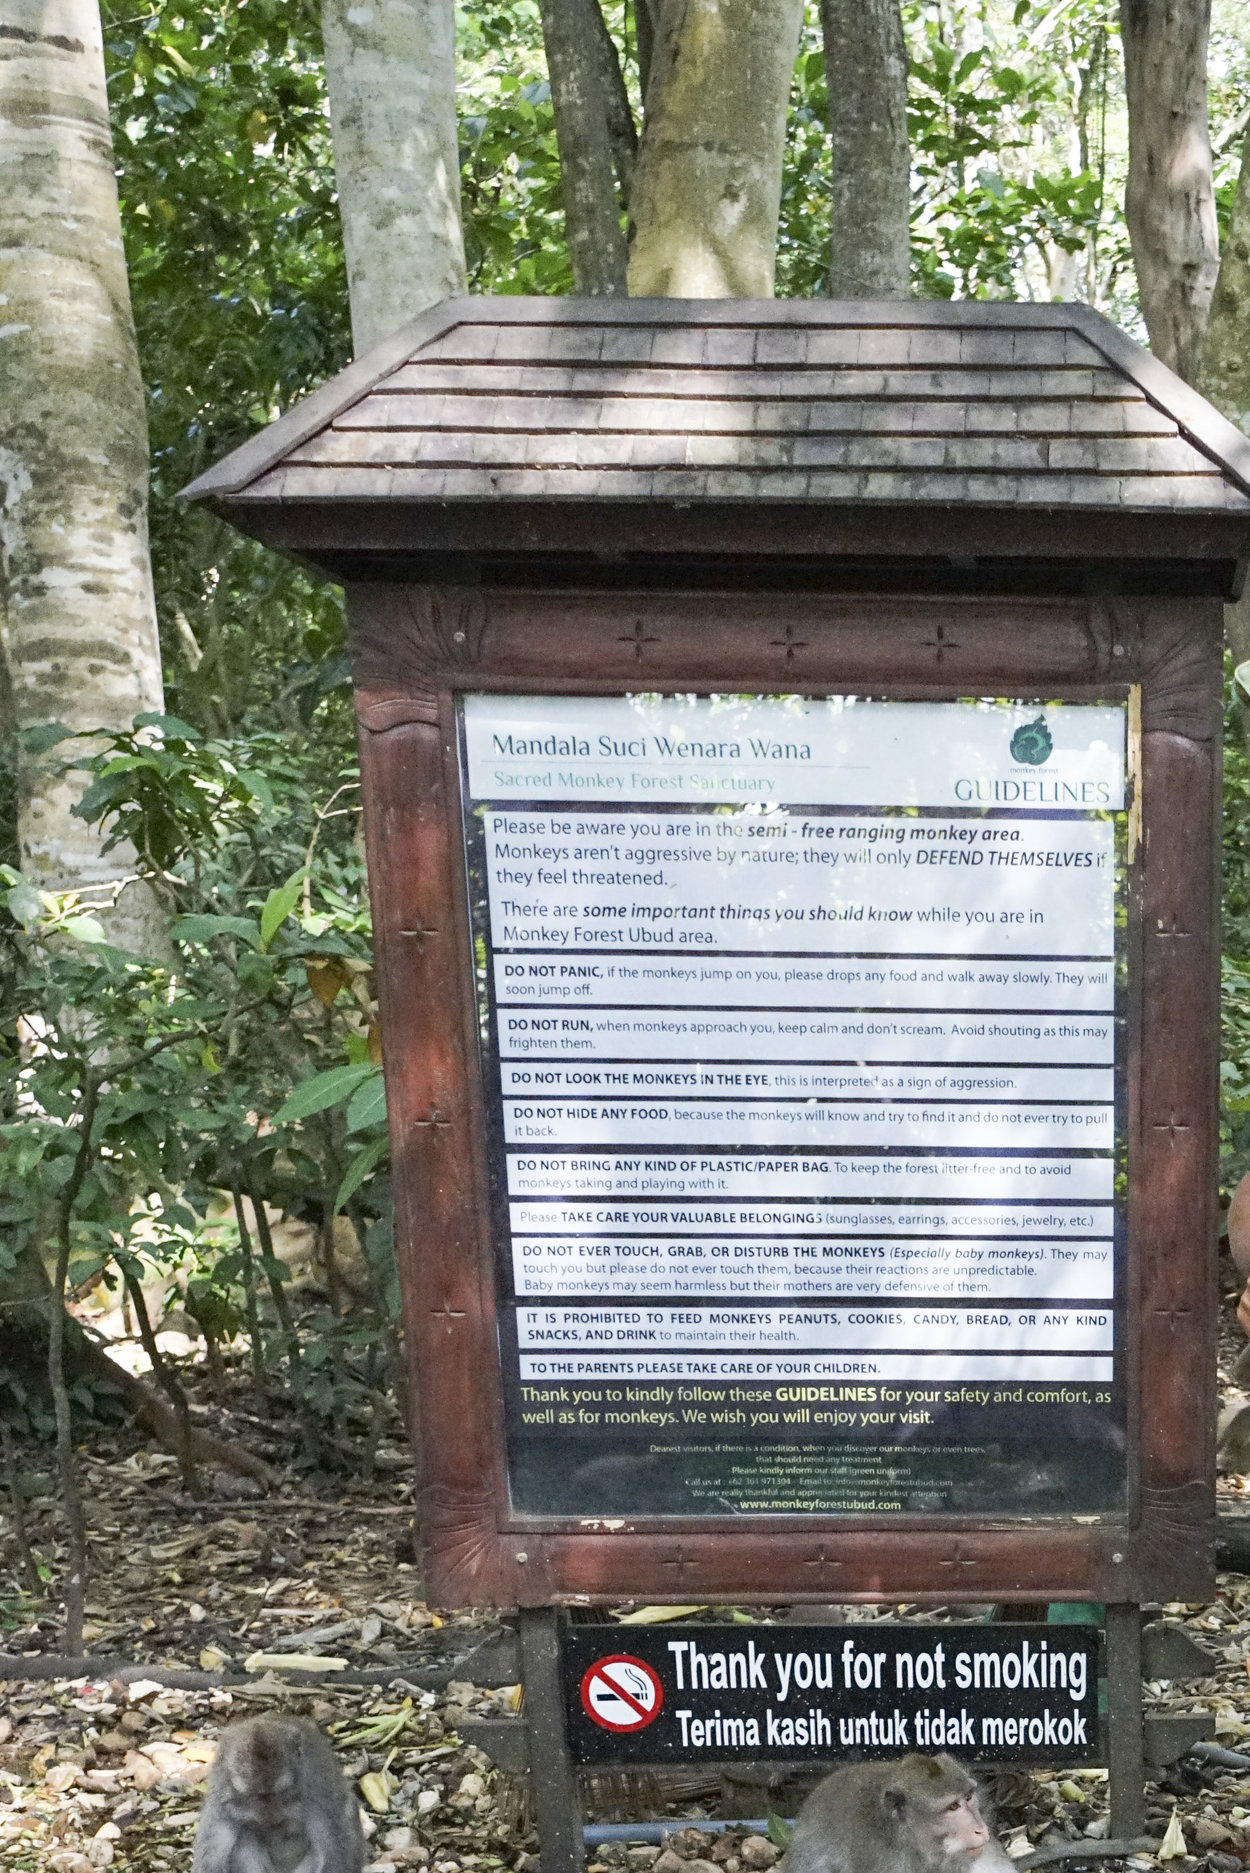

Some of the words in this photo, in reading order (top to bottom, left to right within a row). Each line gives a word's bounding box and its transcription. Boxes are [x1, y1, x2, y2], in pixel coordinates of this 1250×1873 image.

[492, 734, 590, 755] Mandala
[598, 736, 646, 756] Suci
[653, 737, 740, 758] Wenara
[749, 739, 811, 759] Wana
[493, 771, 552, 787] Sacred
[557, 772, 624, 788] Monkey
[630, 772, 683, 789] Forest
[688, 773, 775, 790] Sanctuary
[954, 779, 1110, 802] GUIDELINES
[492, 817, 546, 834] Please
[550, 818, 572, 835] be
[575, 822, 626, 835] aware
[629, 823, 661, 839] you
[665, 823, 691, 836] are
[696, 821, 711, 836] in
[715, 821, 743, 837] the
[746, 822, 788, 838] semi
[800, 821, 835, 838] free
[838, 824, 906, 843] ranging
[909, 824, 978, 844] monkey
[981, 829, 1024, 841] area.
[495, 843, 569, 863] Monkeys
[573, 845, 620, 860] aren't
[624, 846, 712, 865] aggressive
[716, 846, 737, 866] by
[740, 850, 799, 864] nature;
[802, 847, 839, 867] they
[843, 847, 871, 863] will
[875, 848, 911, 868] only
[915, 849, 984, 865] DEFEND
[987, 850, 1093, 867] THEMSELVES
[1096, 851, 1107, 867] if
[495, 868, 533, 887] they
[536, 868, 567, 884] feel
[571, 869, 668, 885] threatened.
[500, 900, 548, 917] There
[552, 905, 578, 917] are
[582, 905, 627, 918] some
[630, 903, 716, 921] important
[719, 903, 770, 920] things
[774, 908, 805, 922] you
[808, 904, 864, 921] should
[867, 906, 913, 921] know
[916, 906, 961, 922] while
[964, 911, 995, 926] you
[999, 911, 1025, 923] are
[1029, 908, 1044, 923] in
[503, 925, 569, 945] Monkey
[573, 926, 624, 942] Forest
[628, 926, 674, 943] Ubud
[678, 931, 717, 944] area.
[508, 1035, 557, 1051] frighten
[560, 1037, 595, 1049] them.
[510, 1071, 531, 1084] DO
[534, 1072, 562, 1084] NOT
[565, 1072, 602, 1084] LOOK
[603, 1072, 629, 1084] THE
[632, 1073, 697, 1085] MONKEYS
[700, 1073, 714, 1085] IN
[716, 1073, 742, 1086] THE
[744, 1073, 772, 1087] EYE,
[774, 1074, 796, 1086] this
[799, 1075, 808, 1086] is
[811, 1075, 878, 1088] interpreted
[881, 1078, 894, 1087] as
[896, 1077, 904, 1087] a
[906, 1078, 931, 1090] sign
[934, 1075, 947, 1088] of
[949, 1077, 1018, 1091] aggression.
[526, 1312, 538, 1323] IT
[544, 1312, 557, 1324] IS
[563, 1312, 641, 1324] PROHIBITED
[645, 1312, 664, 1324] TO
[670, 1312, 702, 1324] FEED
[709, 1313, 772, 1324] MONKEYS
[778, 1313, 841, 1325] PEANUTS,
[847, 1313, 907, 1325] COOKIES,
[912, 1313, 959, 1325] CANDY,
[965, 1314, 1011, 1326] BREAD,
[1017, 1314, 1036, 1325] OR
[1042, 1314, 1069, 1325] ANY
[1075, 1315, 1107, 1326] KIND
[527, 1329, 582, 1340] SNACKS,
[584, 1329, 613, 1340] AND
[616, 1329, 657, 1340] DRINK
[659, 1330, 672, 1340] to
[674, 1329, 726, 1341] maintain
[728, 1329, 756, 1341] their
[758, 1329, 799, 1341] health.
[529, 1362, 547, 1373] TO
[548, 1362, 574, 1373] THE
[576, 1362, 634, 1373] PARENTS
[636, 1362, 684, 1373] PLEASE
[685, 1362, 717, 1374] TAKE
[719, 1362, 753, 1374] CARE
[755, 1362, 773, 1373] OF
[775, 1362, 811, 1373] YOUR
[813, 1362, 880, 1373] CHILDREN.
[519, 1386, 570, 1402] Thank
[571, 1390, 602, 1405] you
[604, 1388, 623, 1402] to
[625, 1386, 674, 1404] kindly
[676, 1385, 726, 1401] follow
[728, 1386, 772, 1402] these
[774, 1386, 877, 1402] GUIDELINES
[879, 1386, 902, 1402] for
[904, 1390, 941, 1405] your
[943, 1386, 990, 1405] safety
[992, 1387, 1022, 1403] and
[1025, 1387, 1091, 1404] comfort,
[1094, 1391, 1111, 1403] as
[521, 1408, 554, 1424] well
[557, 1411, 576, 1424] as
[577, 1407, 601, 1424] for
[604, 1408, 679, 1427] monkeys.
[681, 1408, 707, 1423] We
[709, 1408, 746, 1427] wish
[749, 1412, 779, 1427] you
[781, 1407, 810, 1423] will
[813, 1409, 857, 1426] enjoy
[859, 1411, 896, 1427] your
[898, 1409, 934, 1424] visit.
[739, 1500, 901, 1510] www.monkeyforestubud.com
[666, 1640, 768, 1691] Thank
[773, 1652, 833, 1701] you
[837, 1639, 887, 1689] for
[894, 1643, 951, 1689] not
[953, 1640, 1087, 1700] smoking
[674, 1709, 762, 1747] Terima
[765, 1708, 832, 1746] kasih
[836, 1709, 910, 1746] untuk
[913, 1708, 976, 1745] tidak
[981, 1708, 1088, 1745] merokok
